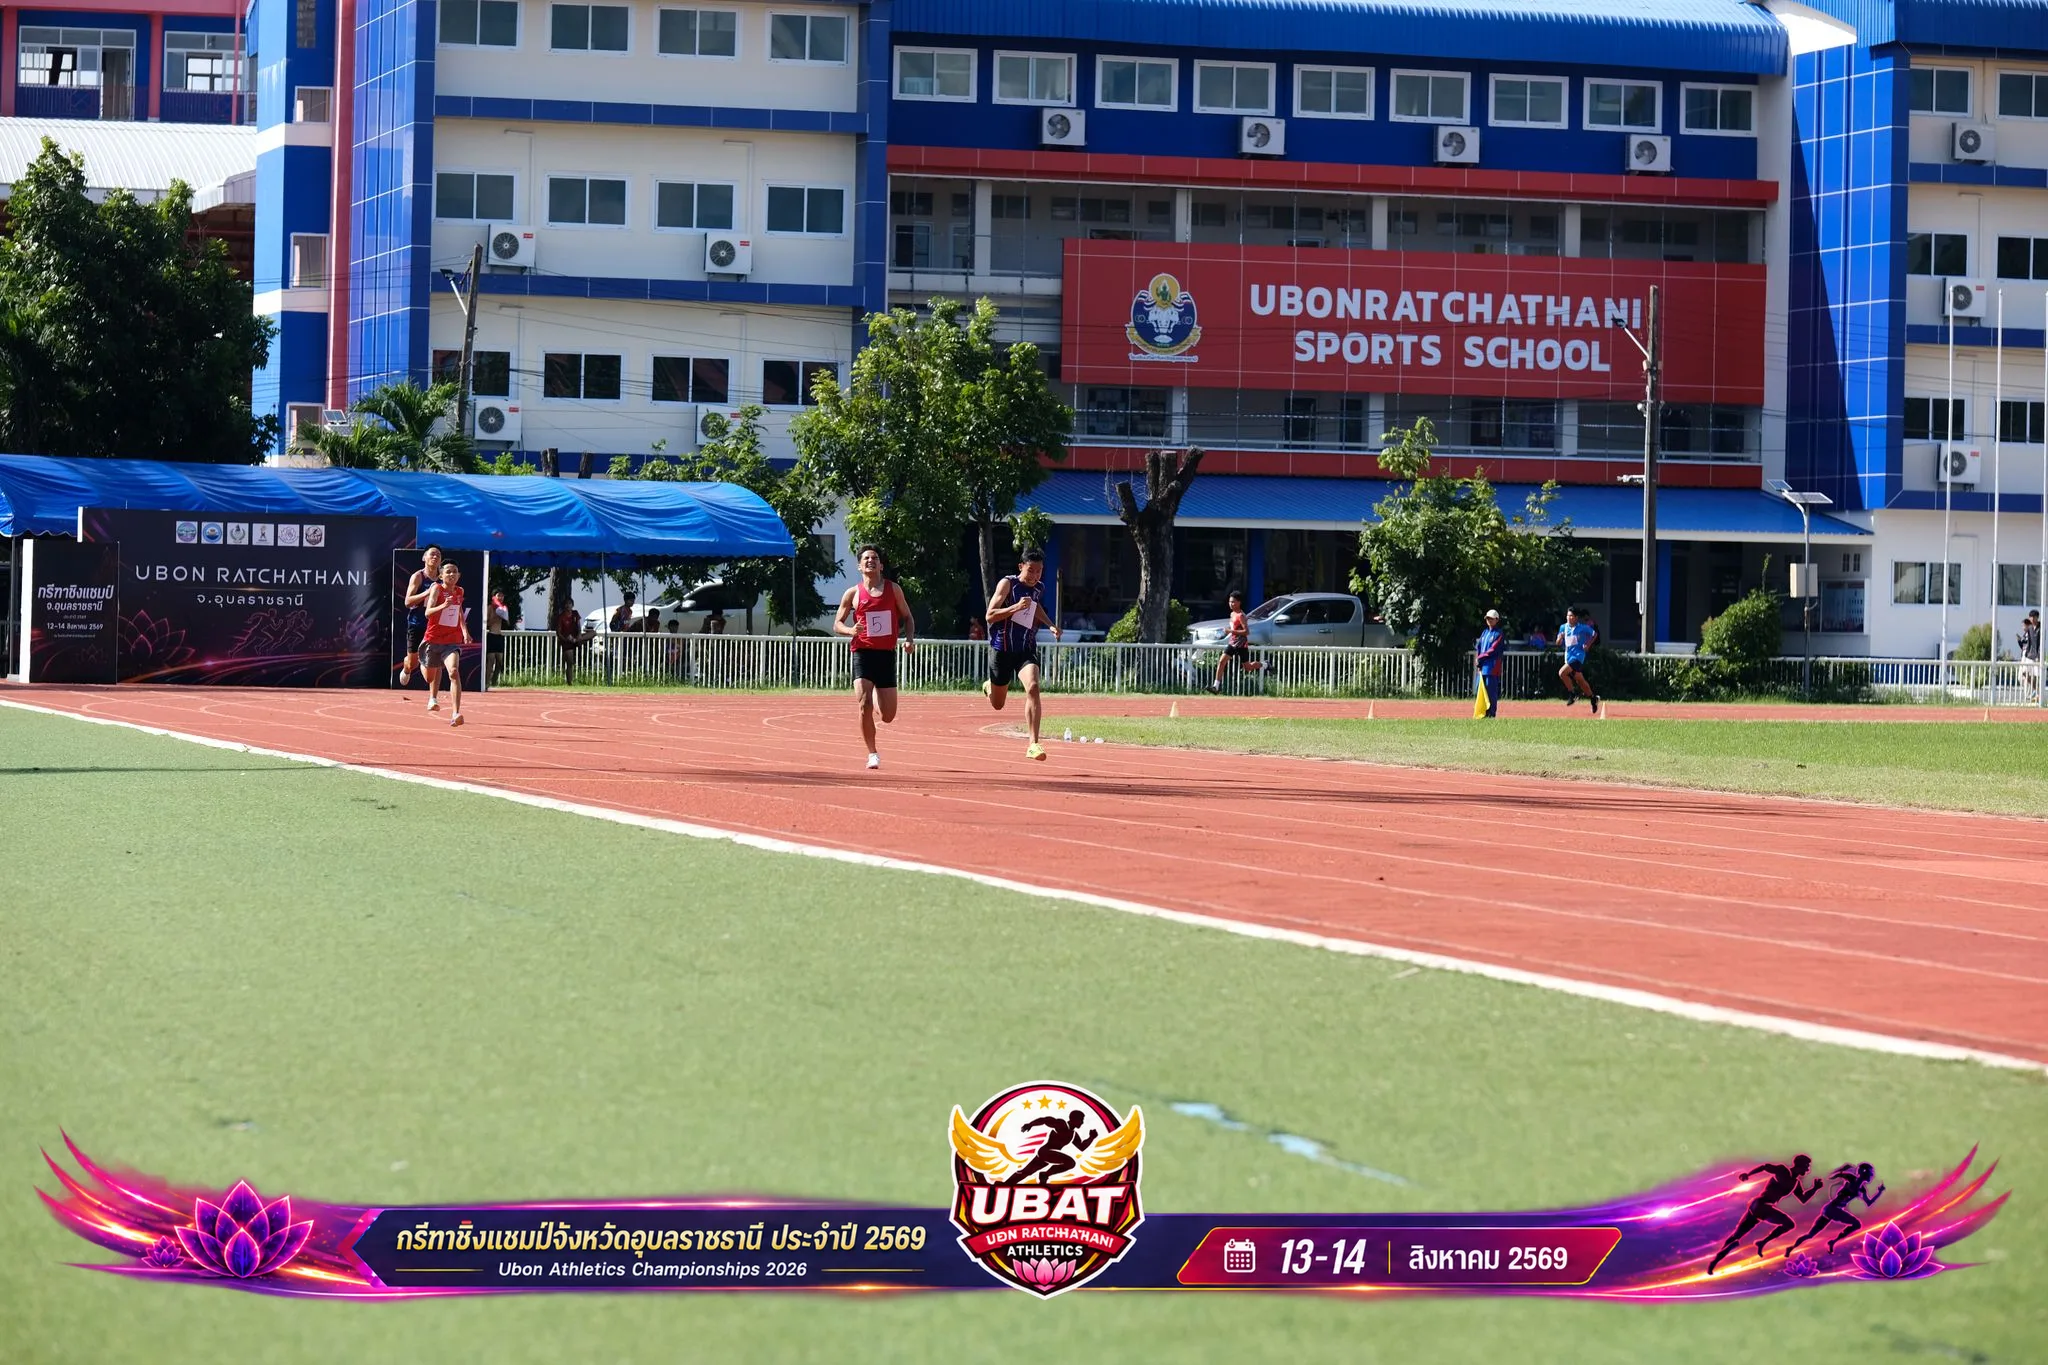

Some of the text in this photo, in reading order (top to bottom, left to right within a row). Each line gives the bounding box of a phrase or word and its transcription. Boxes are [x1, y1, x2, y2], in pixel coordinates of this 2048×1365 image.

[1250, 284, 1642, 330] UBONRATCHATHANI
[1294, 330, 1611, 372] SPORTS SCHOOL
[135, 565, 367, 586] UBON RATCHATHANI
[872, 616, 882, 633] 5
